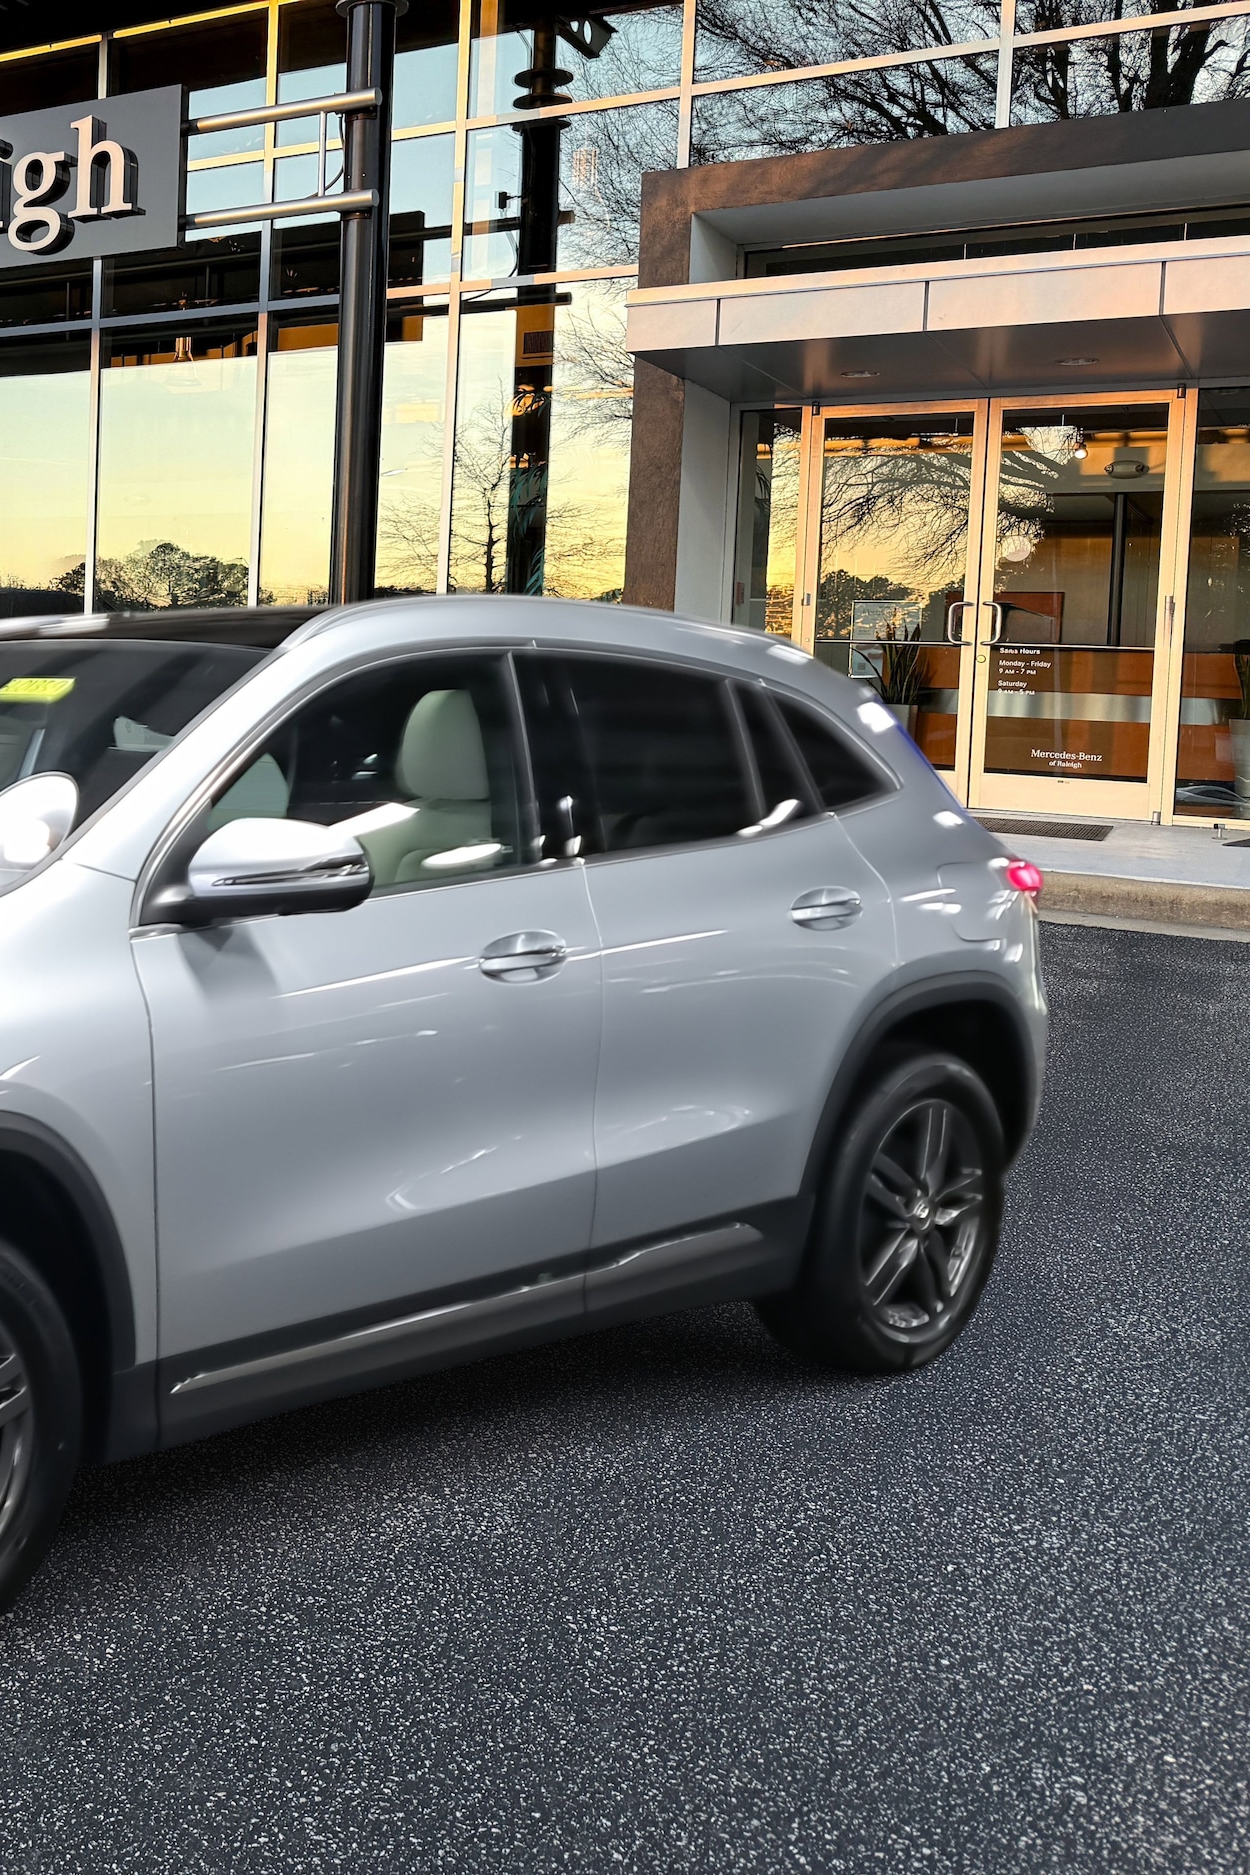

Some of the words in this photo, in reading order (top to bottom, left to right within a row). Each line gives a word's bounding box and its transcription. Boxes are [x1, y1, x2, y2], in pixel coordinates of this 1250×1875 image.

[1030, 661, 1051, 669] Friday
[998, 680, 1028, 688] Saturday
[1031, 749, 1103, 762] Mercedes-Benz
[1057, 761, 1082, 769] Raleigh
